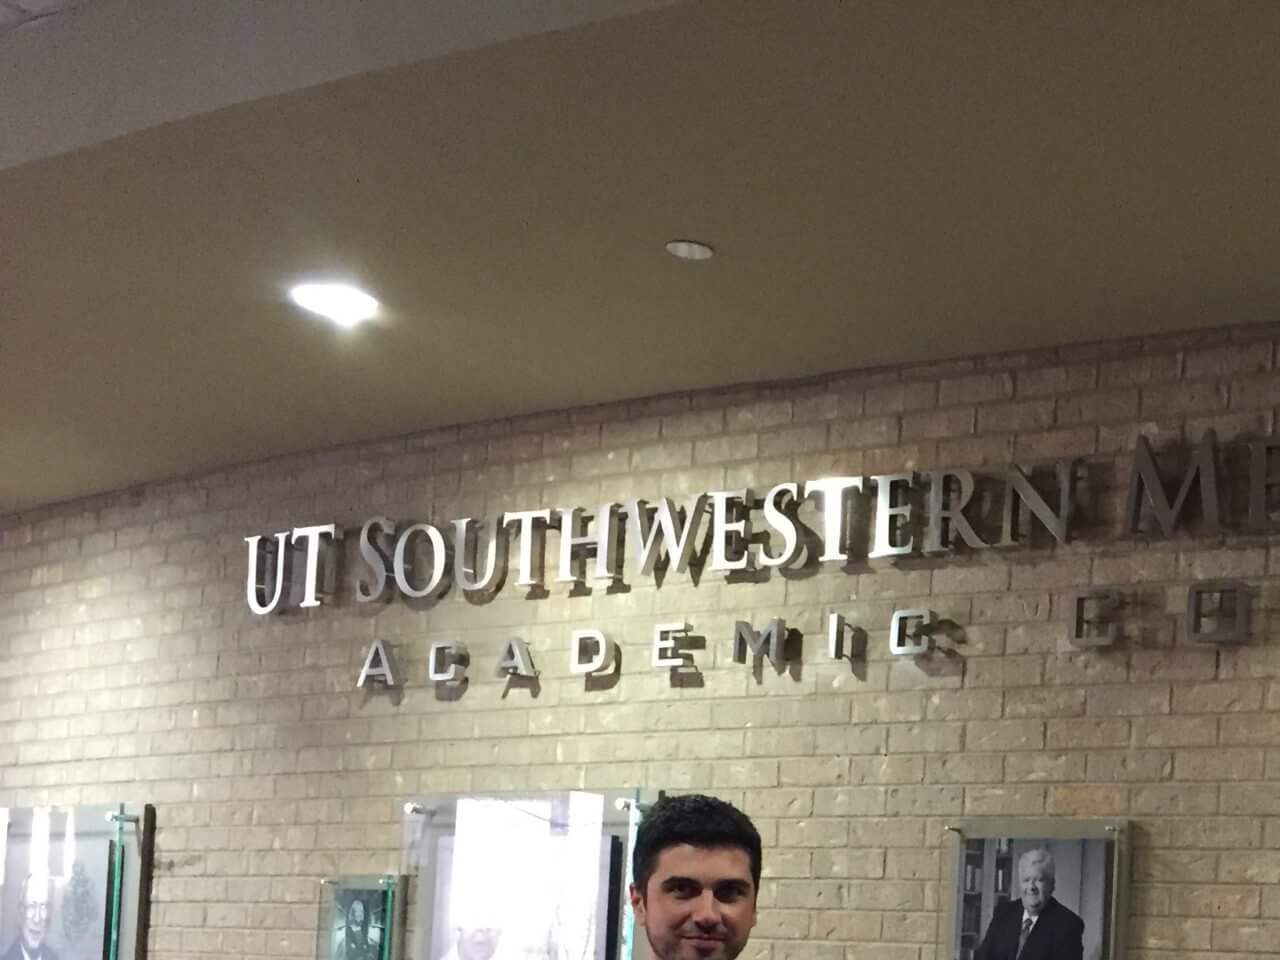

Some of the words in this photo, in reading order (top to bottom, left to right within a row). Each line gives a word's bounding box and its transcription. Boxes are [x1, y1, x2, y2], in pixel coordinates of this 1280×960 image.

[244, 524, 335, 615] UT
[354, 460, 1085, 604] SOUTHWESTERN
[356, 608, 934, 688] ACADEMIC
